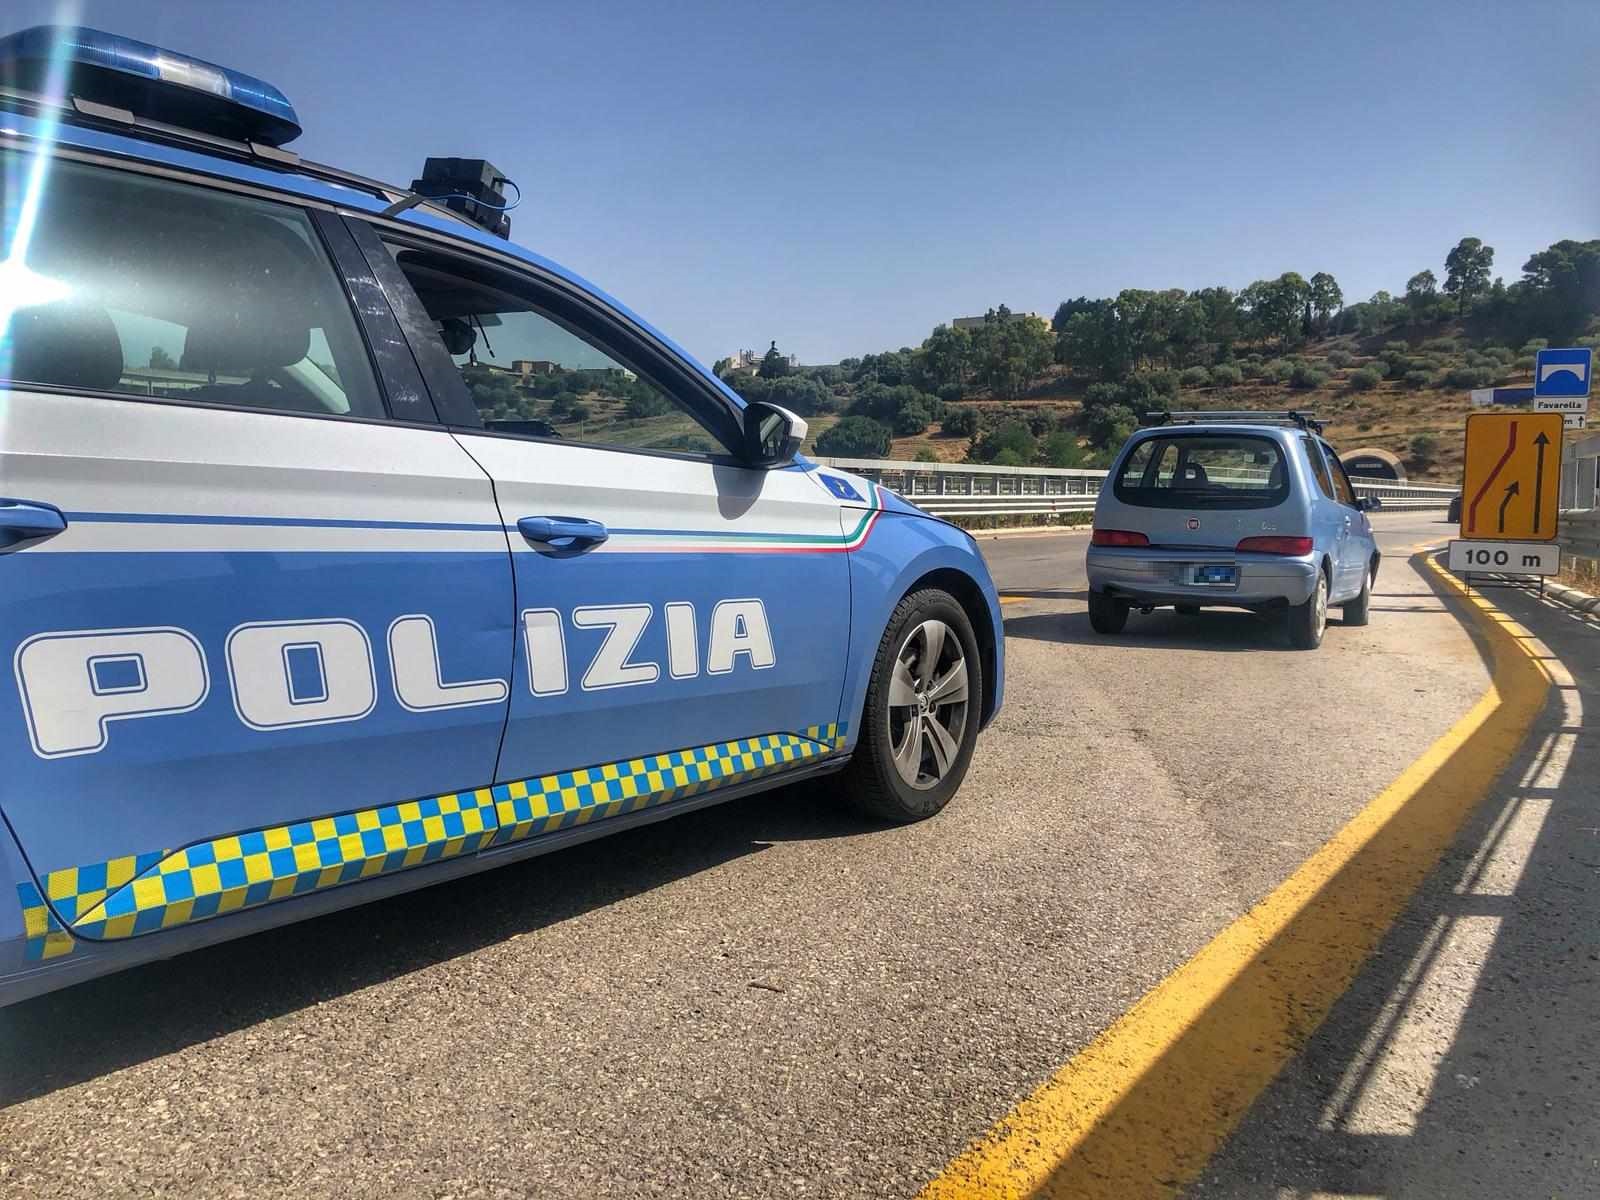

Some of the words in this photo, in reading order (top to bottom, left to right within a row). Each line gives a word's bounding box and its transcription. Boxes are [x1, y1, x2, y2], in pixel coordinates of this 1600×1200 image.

[1538, 401, 1582, 409] Favarella
[1465, 549, 1508, 565] 100
[1522, 555, 1540, 567] m
[14, 598, 776, 759] POLIZIA
